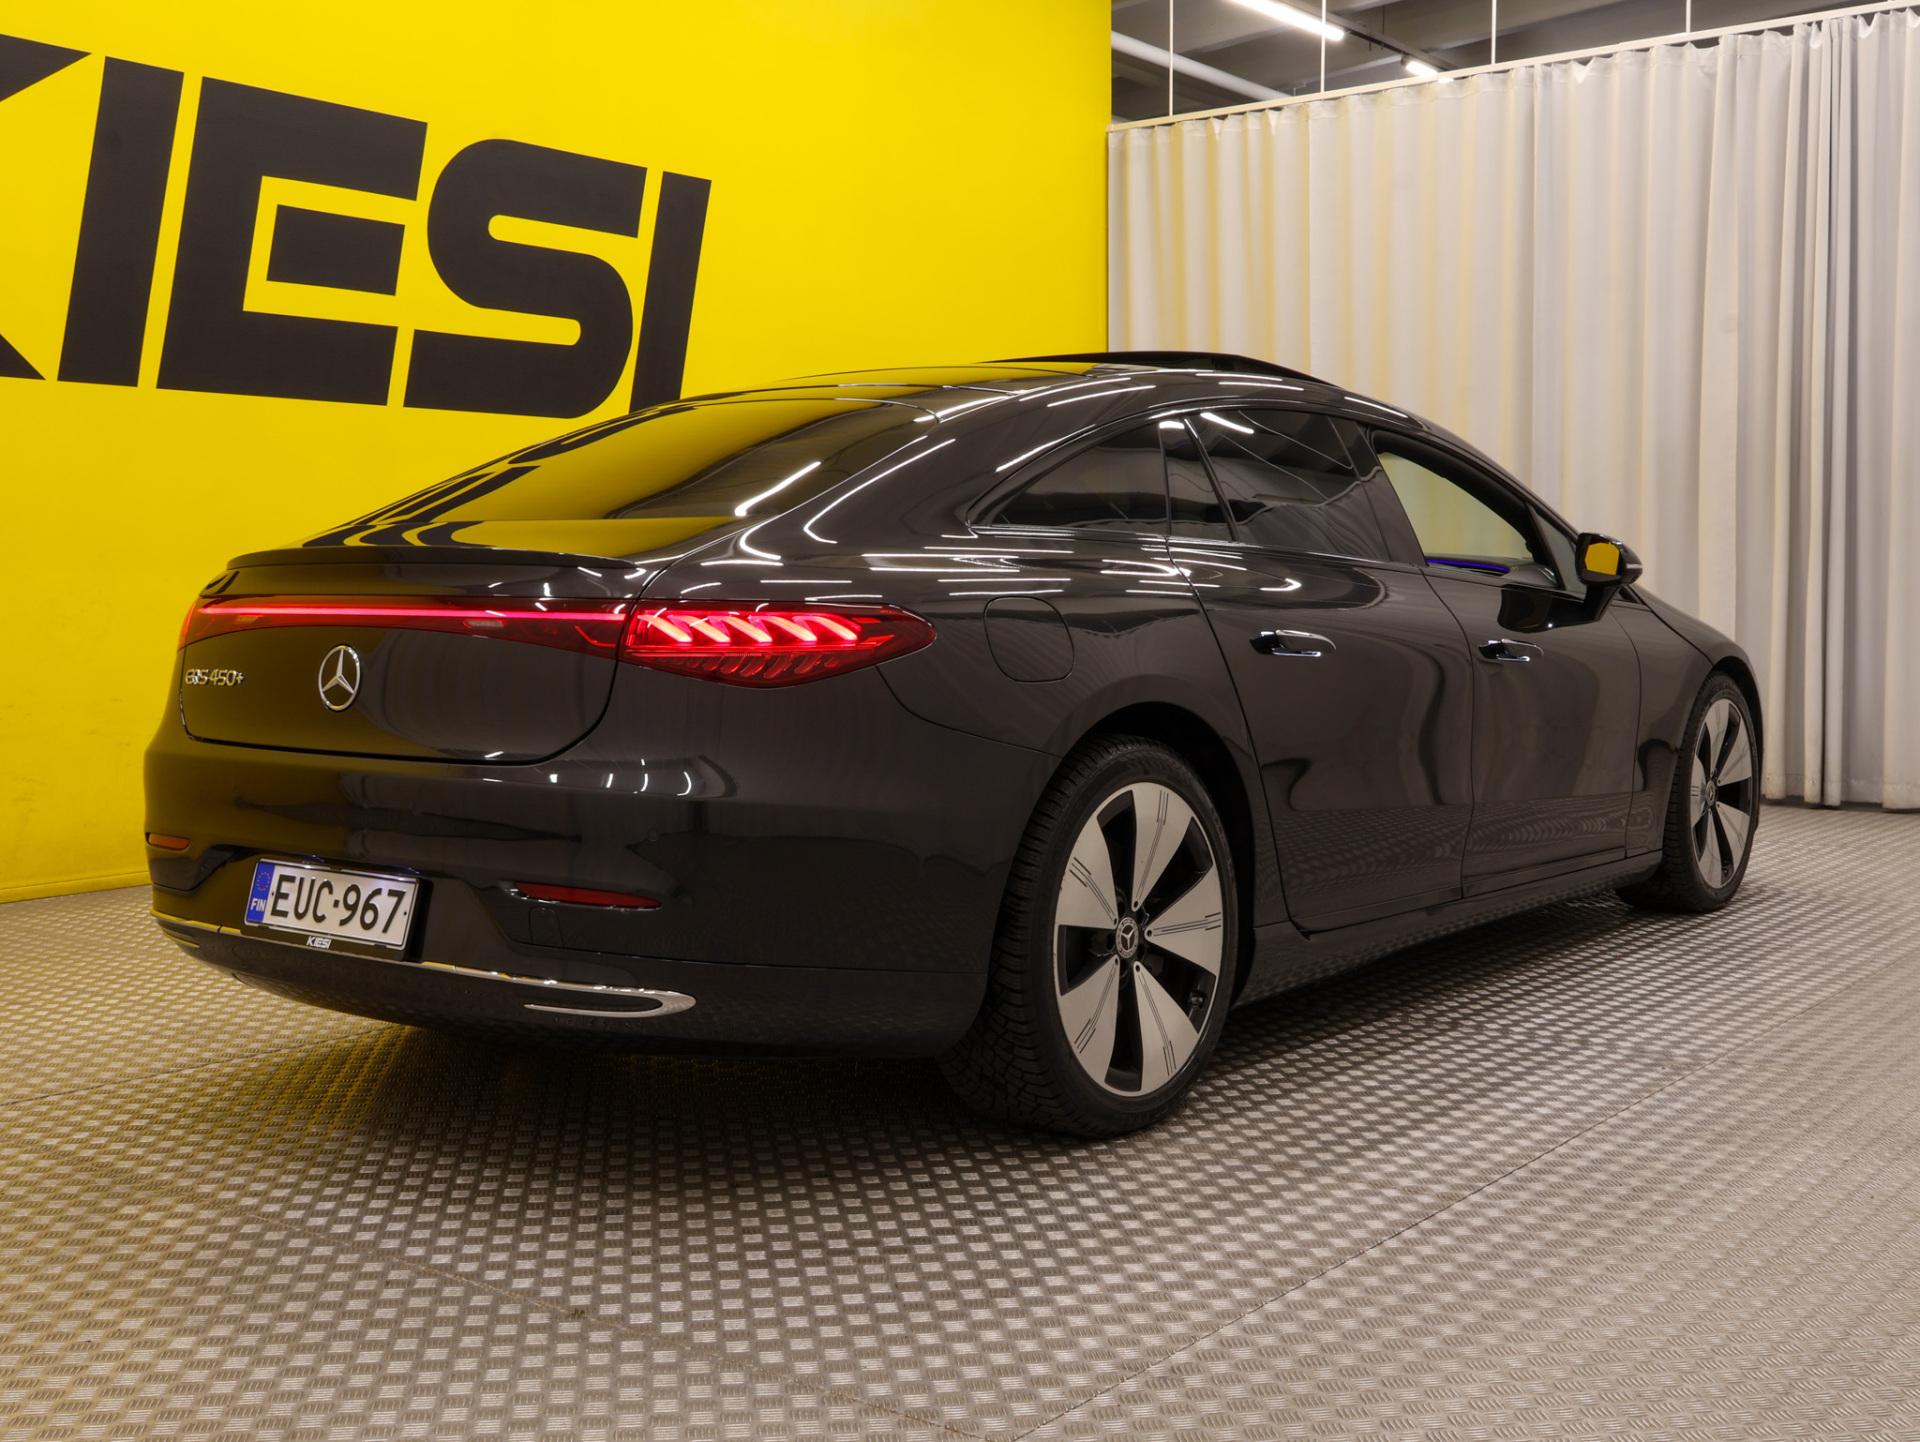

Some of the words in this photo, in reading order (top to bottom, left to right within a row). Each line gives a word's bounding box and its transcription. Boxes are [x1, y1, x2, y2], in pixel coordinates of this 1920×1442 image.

[209, 668, 244, 687] 450+
[250, 897, 267, 912] FIN
[306, 935, 332, 949] KIESI
